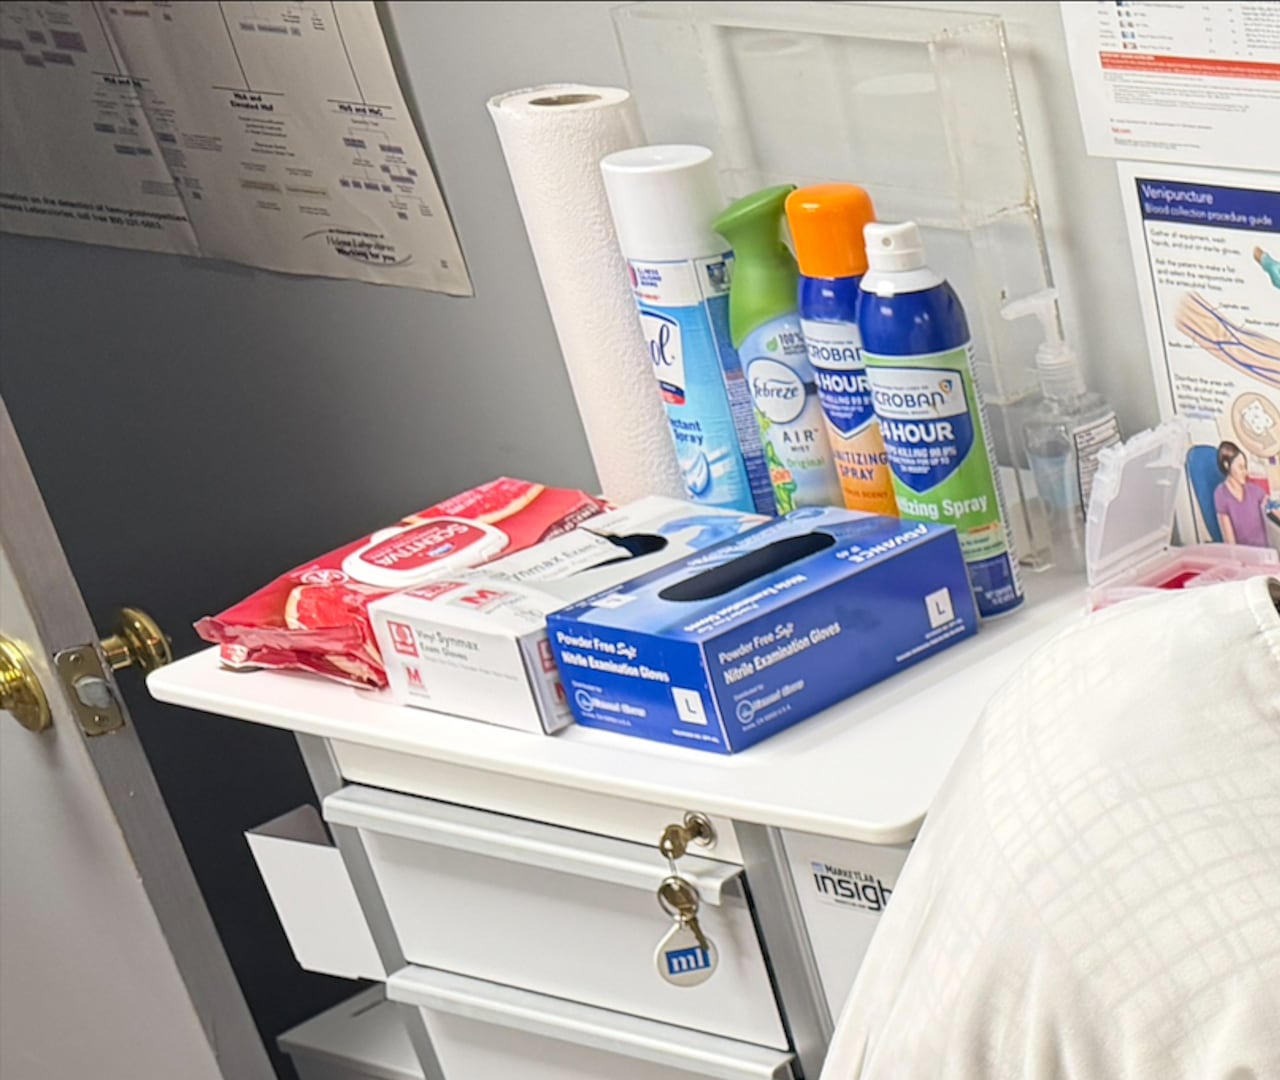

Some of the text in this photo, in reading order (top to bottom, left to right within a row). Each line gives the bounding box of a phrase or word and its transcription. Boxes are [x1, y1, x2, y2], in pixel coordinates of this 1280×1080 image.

[1141, 184, 1214, 205] Venipuncture
[1144, 203, 1272, 227] Blood collection procedure guide
[650, 324, 672, 366] ol
[753, 377, 799, 400] febreze
[893, 421, 955, 444] HOUR
[942, 495, 988, 519] Spray
[436, 631, 480, 651] Synmax
[556, 631, 593, 650] Powder
[594, 638, 616, 654] Free
[718, 641, 753, 665] Powder
[753, 632, 774, 649] Free
[723, 622, 841, 685] Nitrile Examination Gloves
[405, 666, 423, 685] M
[561, 651, 670, 683] Nitrile Examination Gloves
[813, 873, 893, 912] insigh
[671, 947, 705, 972] ml
